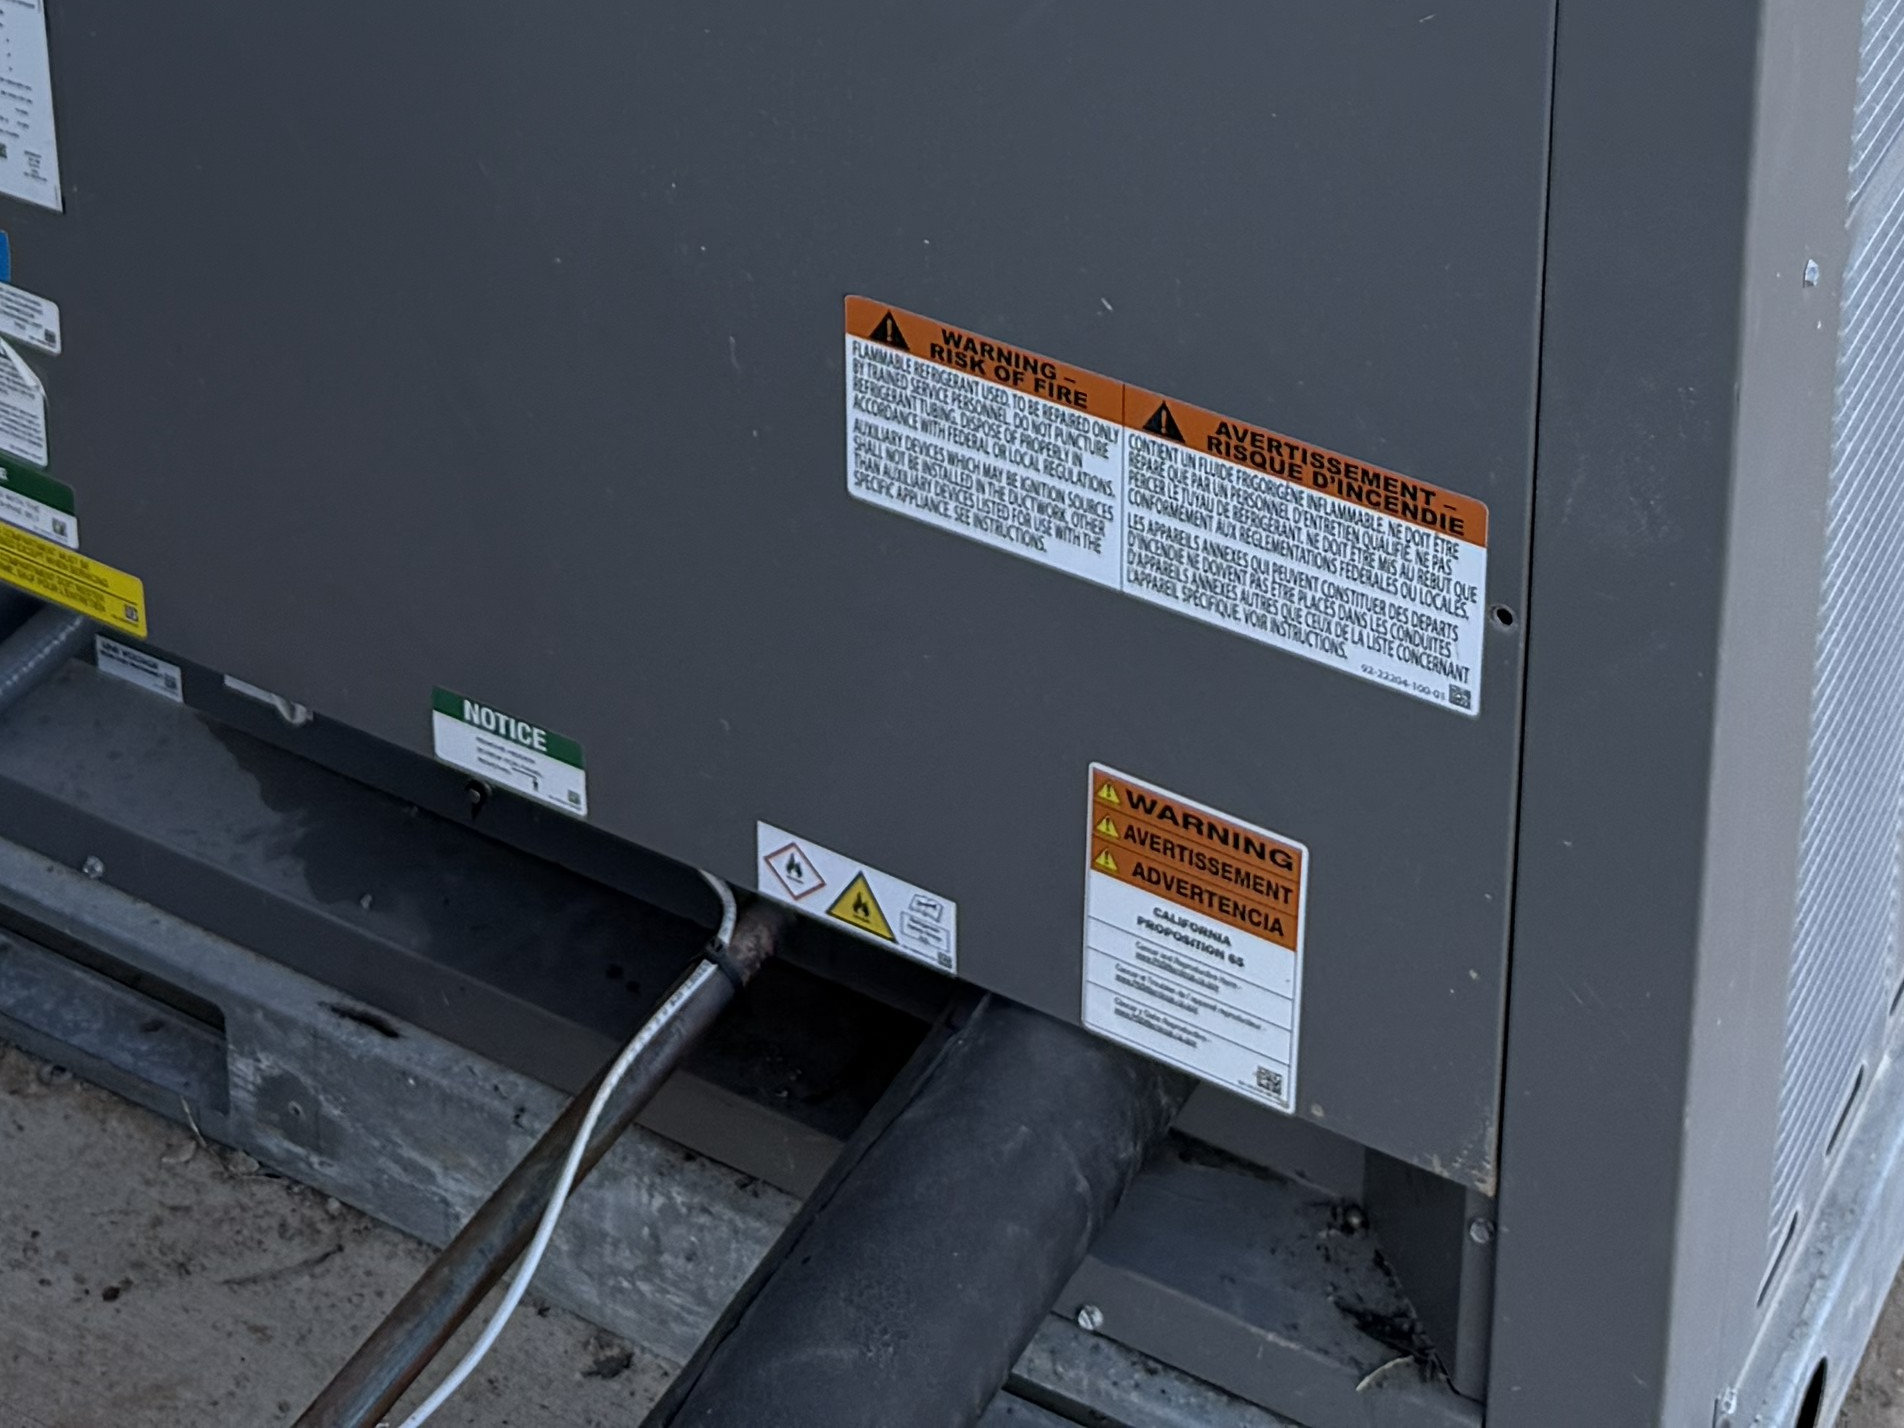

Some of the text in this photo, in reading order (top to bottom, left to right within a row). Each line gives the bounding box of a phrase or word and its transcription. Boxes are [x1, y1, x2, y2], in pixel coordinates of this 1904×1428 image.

[852, 340, 910, 374] FLAMMABLE
[1012, 393, 1025, 412] TO
[1028, 398, 1039, 417] BE
[1092, 419, 1119, 443] ONLY
[930, 342, 1087, 409] RISK OF FIRE
[941, 328, 1056, 380] WARNING
[853, 392, 917, 431] ACCORDANCE
[921, 415, 945, 440] WITH
[948, 424, 989, 455] FEDERAL
[992, 439, 1006, 461] OR
[1008, 445, 1039, 472] LOCAL
[867, 362, 908, 392] TRAINED
[910, 376, 948, 405] SERVICE
[1013, 411, 1029, 432] DO
[1031, 416, 1051, 439] NOT
[960, 411, 1001, 440] DISPOSE
[1004, 425, 1017, 446] OF
[1020, 431, 1068, 463] PROPERLY
[1071, 448, 1082, 468] IN
[853, 434, 882, 460] SHALL
[885, 445, 905, 468] NOT
[922, 458, 972, 491] INSTALLED
[988, 480, 1005, 502] THE
[1071, 509, 1104, 537] OTHER
[904, 435, 944, 464] DEVICES
[947, 449, 979, 476] WHICH
[983, 461, 1002, 483] MAY
[1006, 469, 1017, 489] BE
[1020, 474, 1064, 505] IGNITION
[1068, 490, 1113, 521] SOURCES
[1207, 435, 1302, 483] RISQUE
[1215, 420, 1436, 507] AVERTISSEMENT
[854, 452, 879, 476] THAN
[934, 480, 974, 509] DEVICES
[976, 494, 1008, 521] LISTED
[1012, 506, 1031, 529] FOR
[1034, 514, 1051, 536] USE
[1055, 521, 1080, 546] WITH
[1083, 531, 1101, 553] THE
[954, 504, 970, 526] SEE
[1127, 511, 1144, 534] LES
[1250, 553, 1269, 576] QUI
[1321, 577, 1386, 616] CONSTITUER
[1388, 600, 1408, 624] DES
[462, 698, 549, 753] NOTICE
[1123, 821, 1293, 906] AVERTISSEMENT
[1125, 788, 1293, 872] WARNING
[1131, 859, 1284, 937] ADVERTENCIA
[1152, 905, 1231, 947] CALIFORNIA
[1136, 914, 1224, 960] PROPOSITION
[1228, 951, 1244, 968] 65
